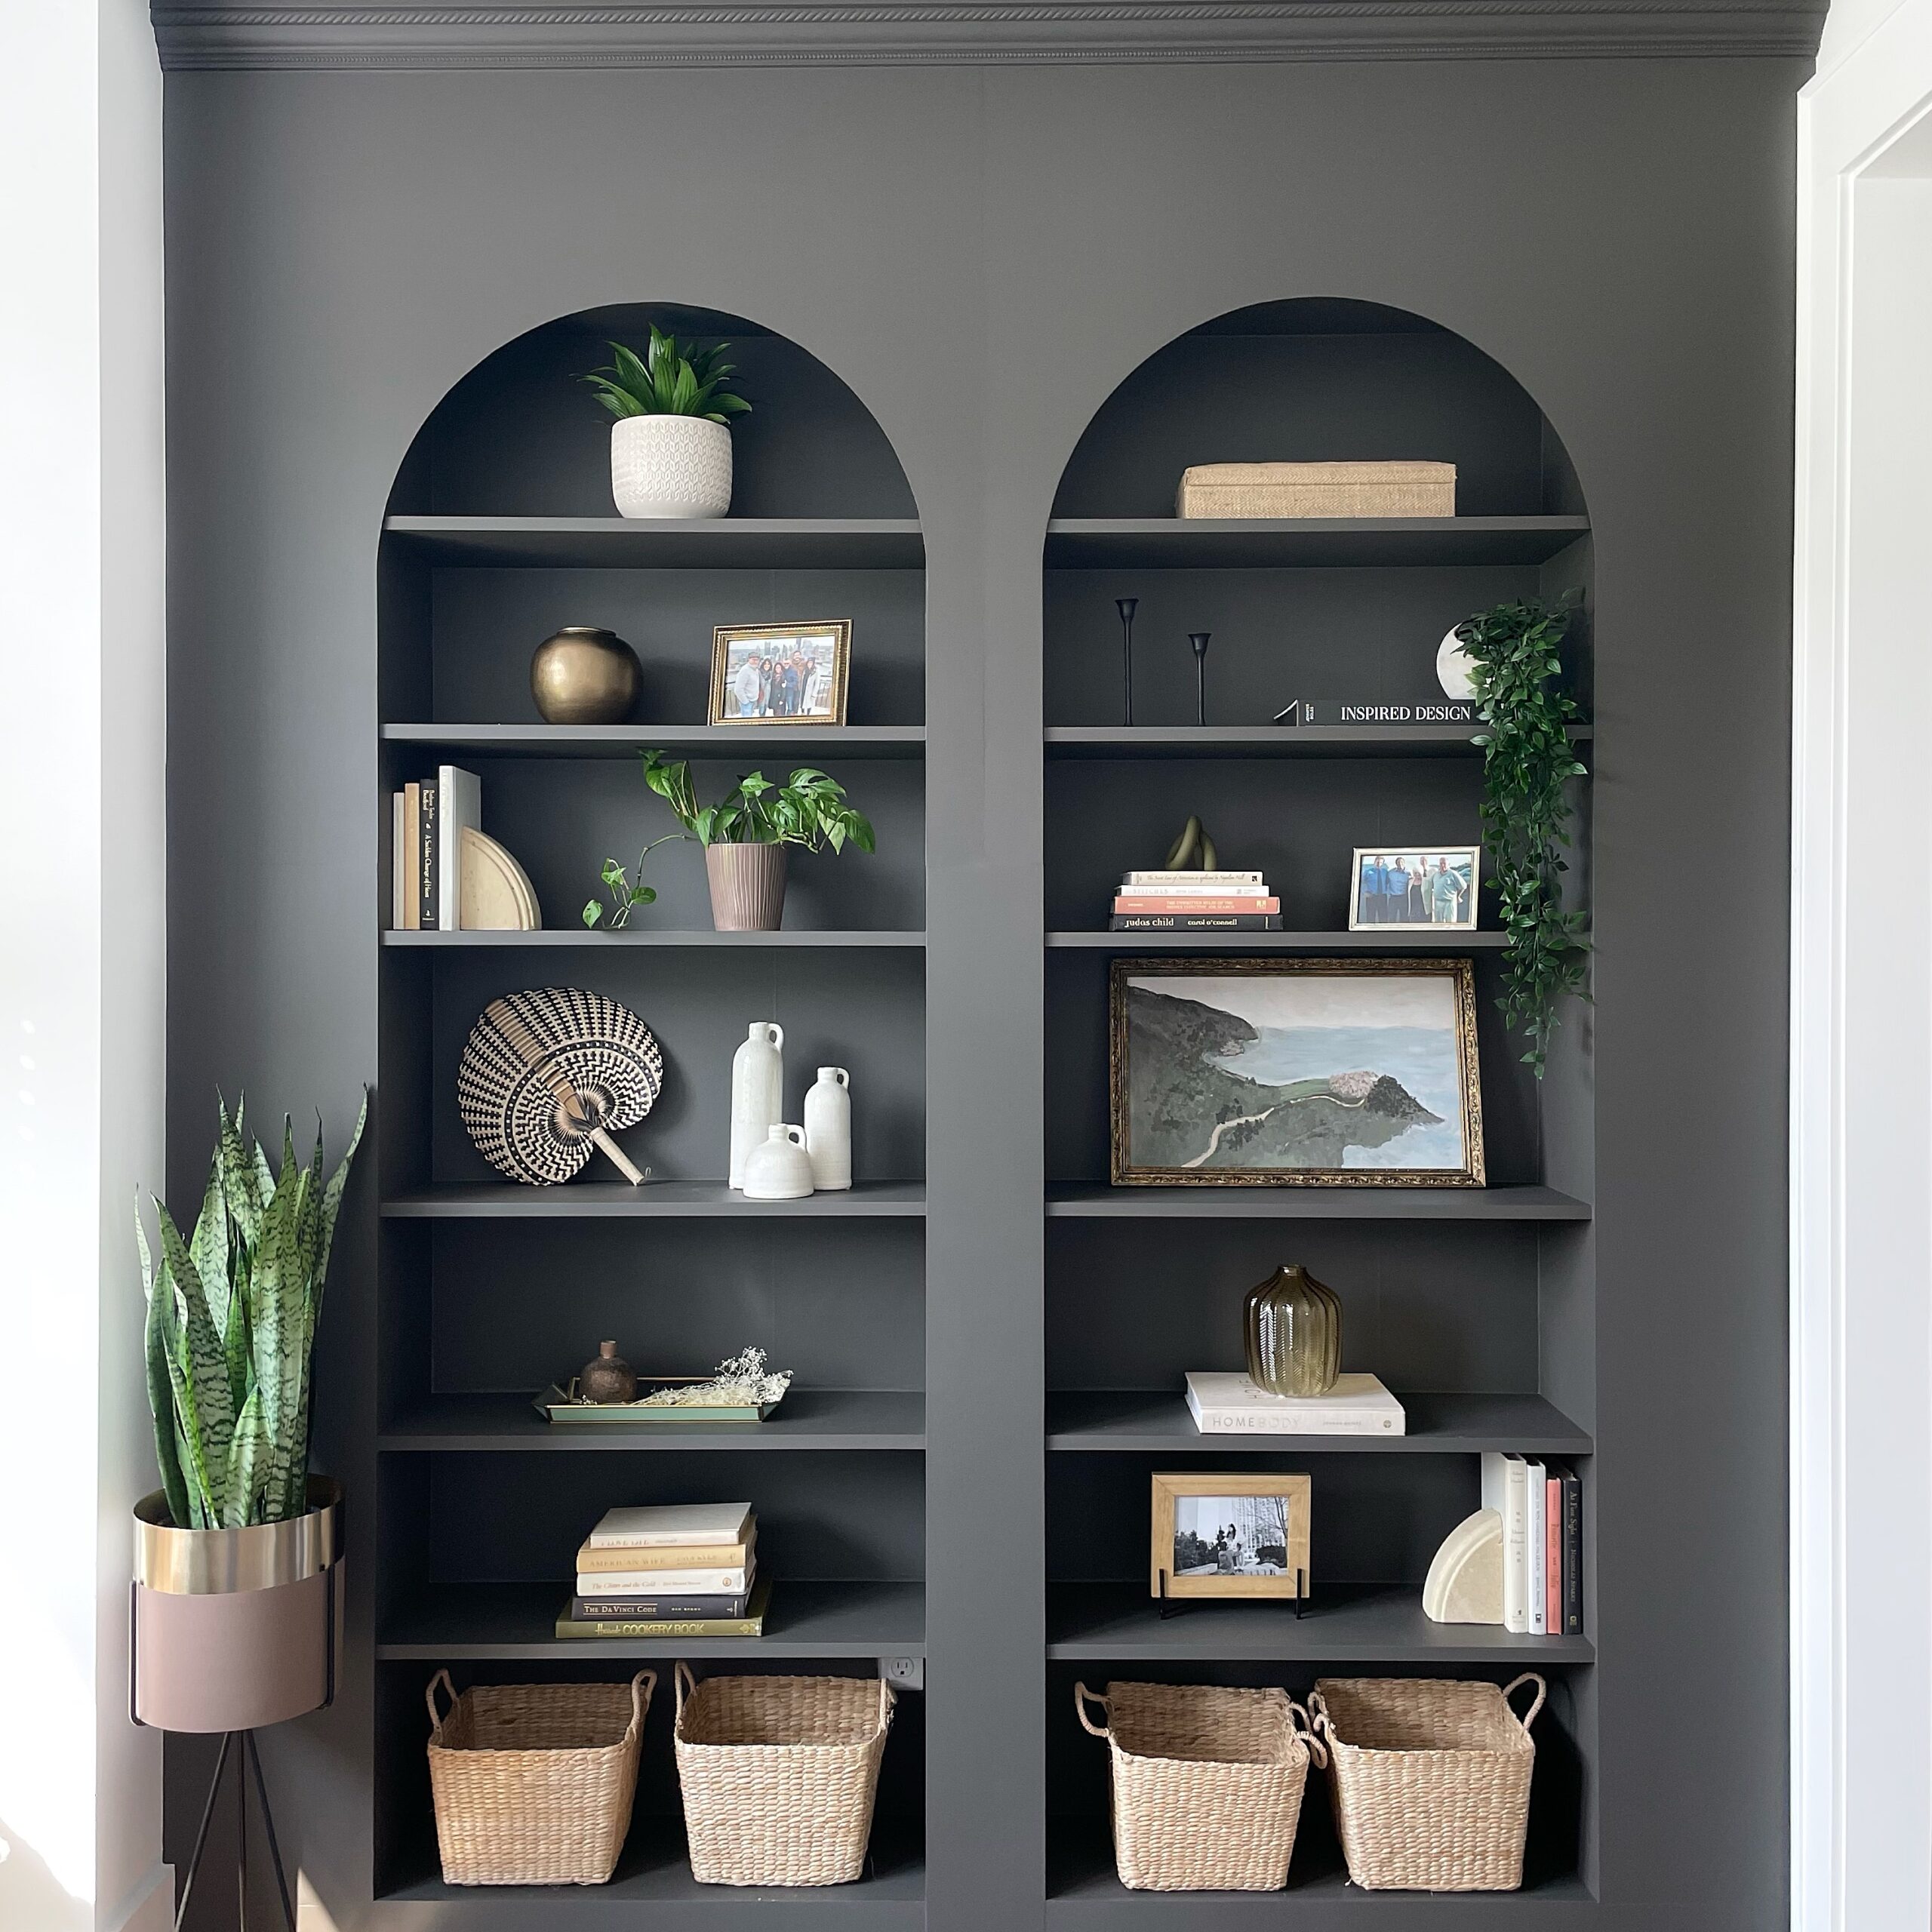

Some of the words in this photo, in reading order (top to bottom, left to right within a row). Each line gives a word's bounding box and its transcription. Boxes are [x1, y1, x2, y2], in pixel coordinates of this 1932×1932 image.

[1340, 706, 1411, 721] INSPIRED
[1415, 706, 1471, 721] DESIGN
[423, 858, 432, 878] Change
[1152, 918, 1174, 927] child
[1570, 1491, 1577, 1500] At
[589, 1559, 640, 1567] AMERICAN
[623, 1624, 672, 1635] COOKERY
[674, 1623, 704, 1634] BOOK
